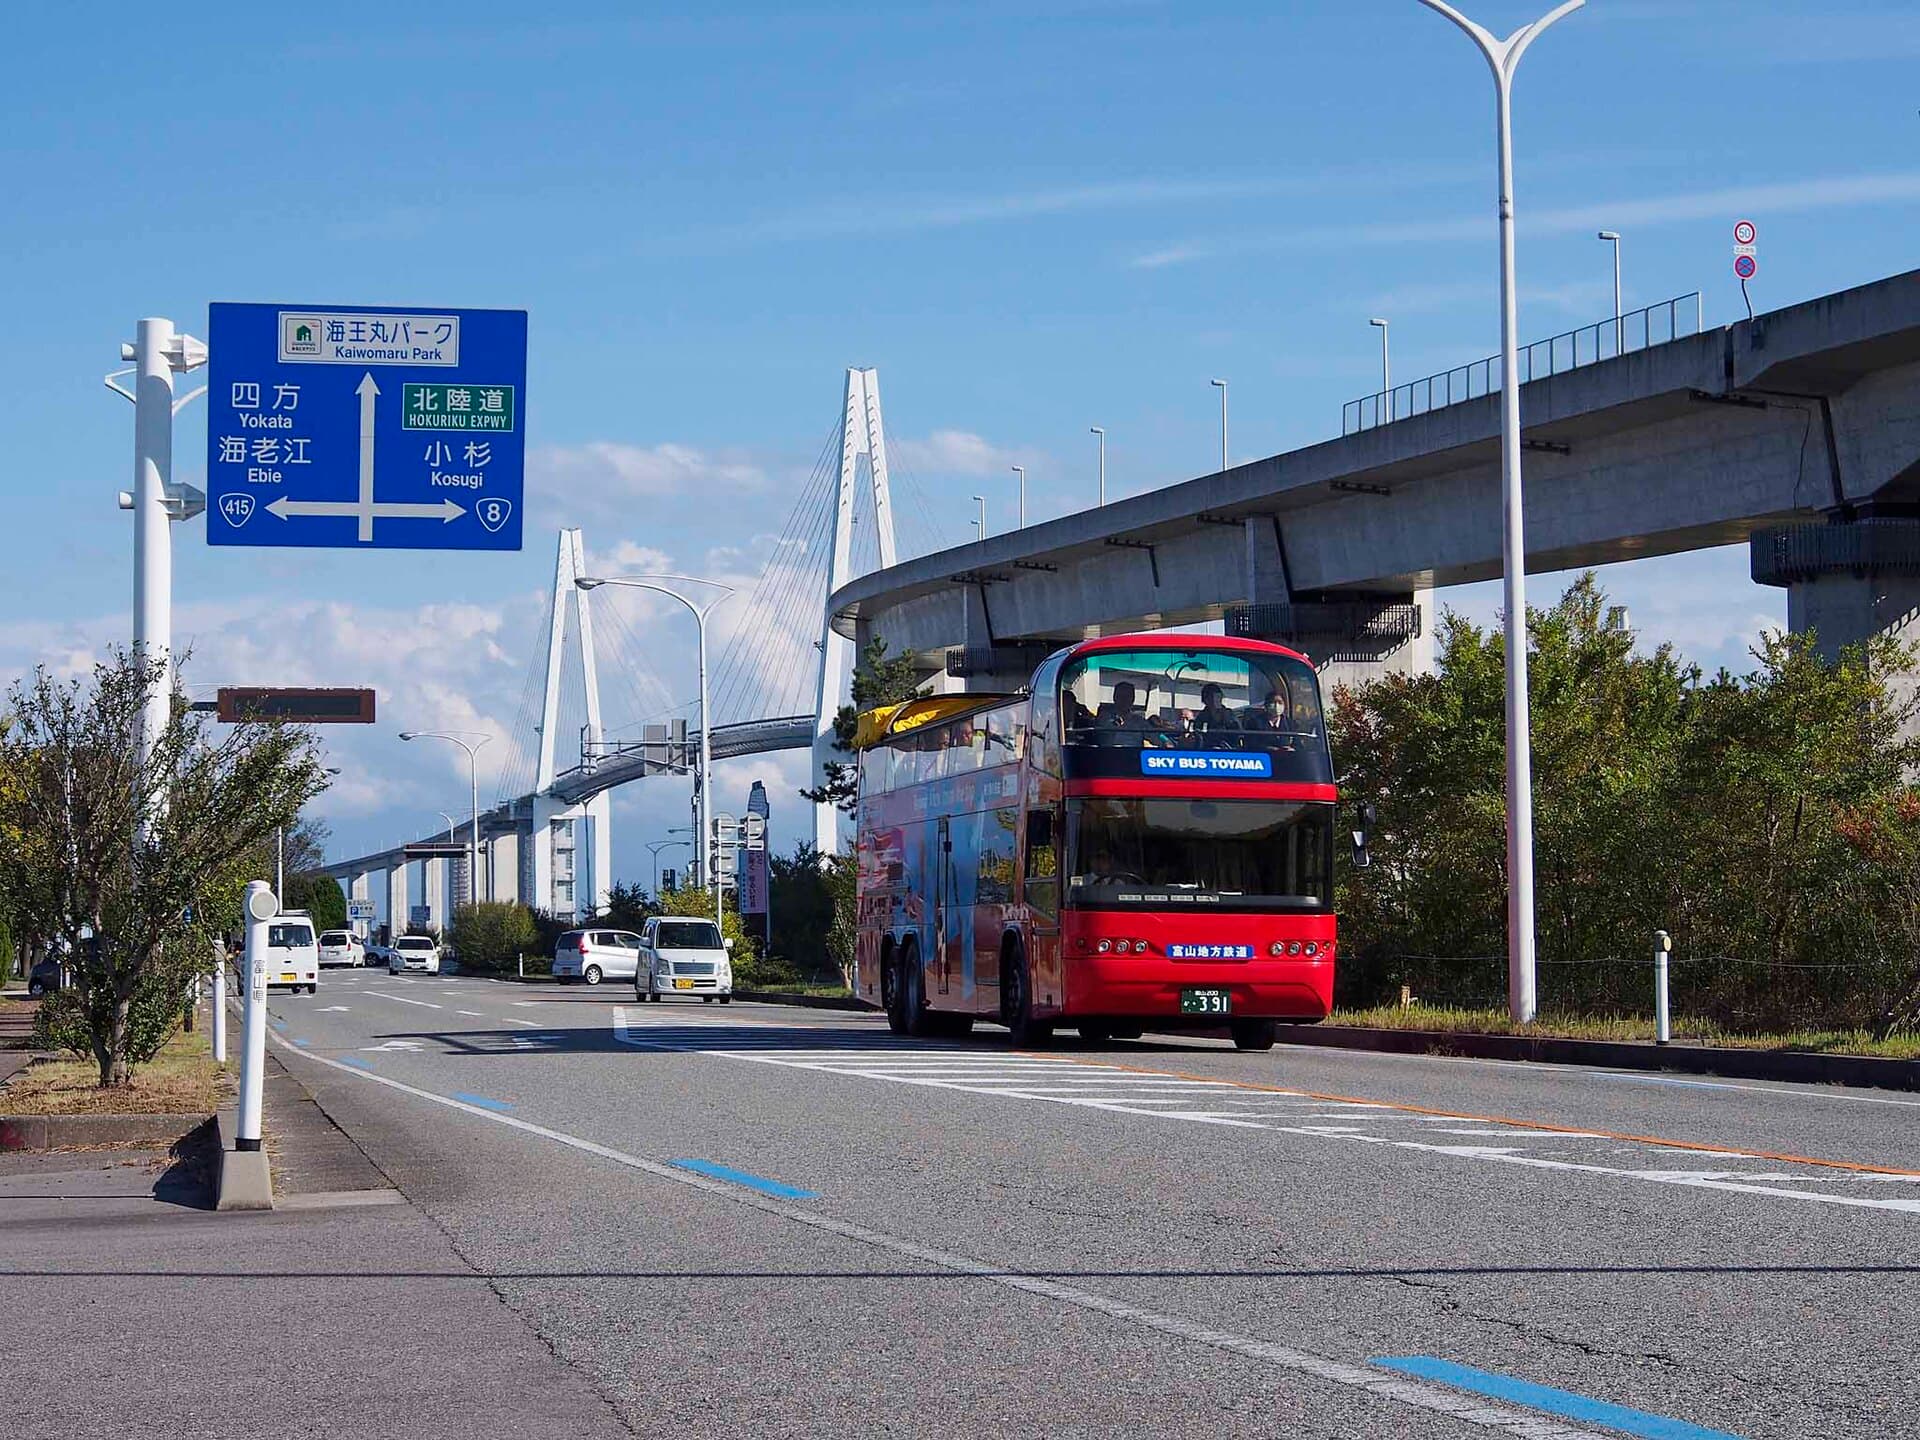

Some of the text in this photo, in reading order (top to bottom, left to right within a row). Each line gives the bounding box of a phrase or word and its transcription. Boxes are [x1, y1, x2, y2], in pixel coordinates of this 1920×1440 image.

[1739, 228, 1751, 238] 50
[326, 320, 453, 345] 海王丸パーク
[335, 345, 442, 361] Kaiwomaru Park
[231, 382, 301, 411] 四方
[412, 388, 505, 413] 北陸道
[239, 413, 293, 430] Yokata
[409, 413, 507, 429] HOKURIKU EXPWY
[218, 435, 312, 465] 海老江
[424, 440, 492, 469] 小杉
[248, 468, 282, 484] Ebie
[431, 471, 484, 489] Kosugi
[225, 499, 249, 516] 415
[486, 503, 501, 523] 8
[1147, 757, 1265, 771] SKY BUS TOYAMA
[1172, 945, 1248, 958] 富山地方鉄道
[253, 959, 265, 1005] 富山県
